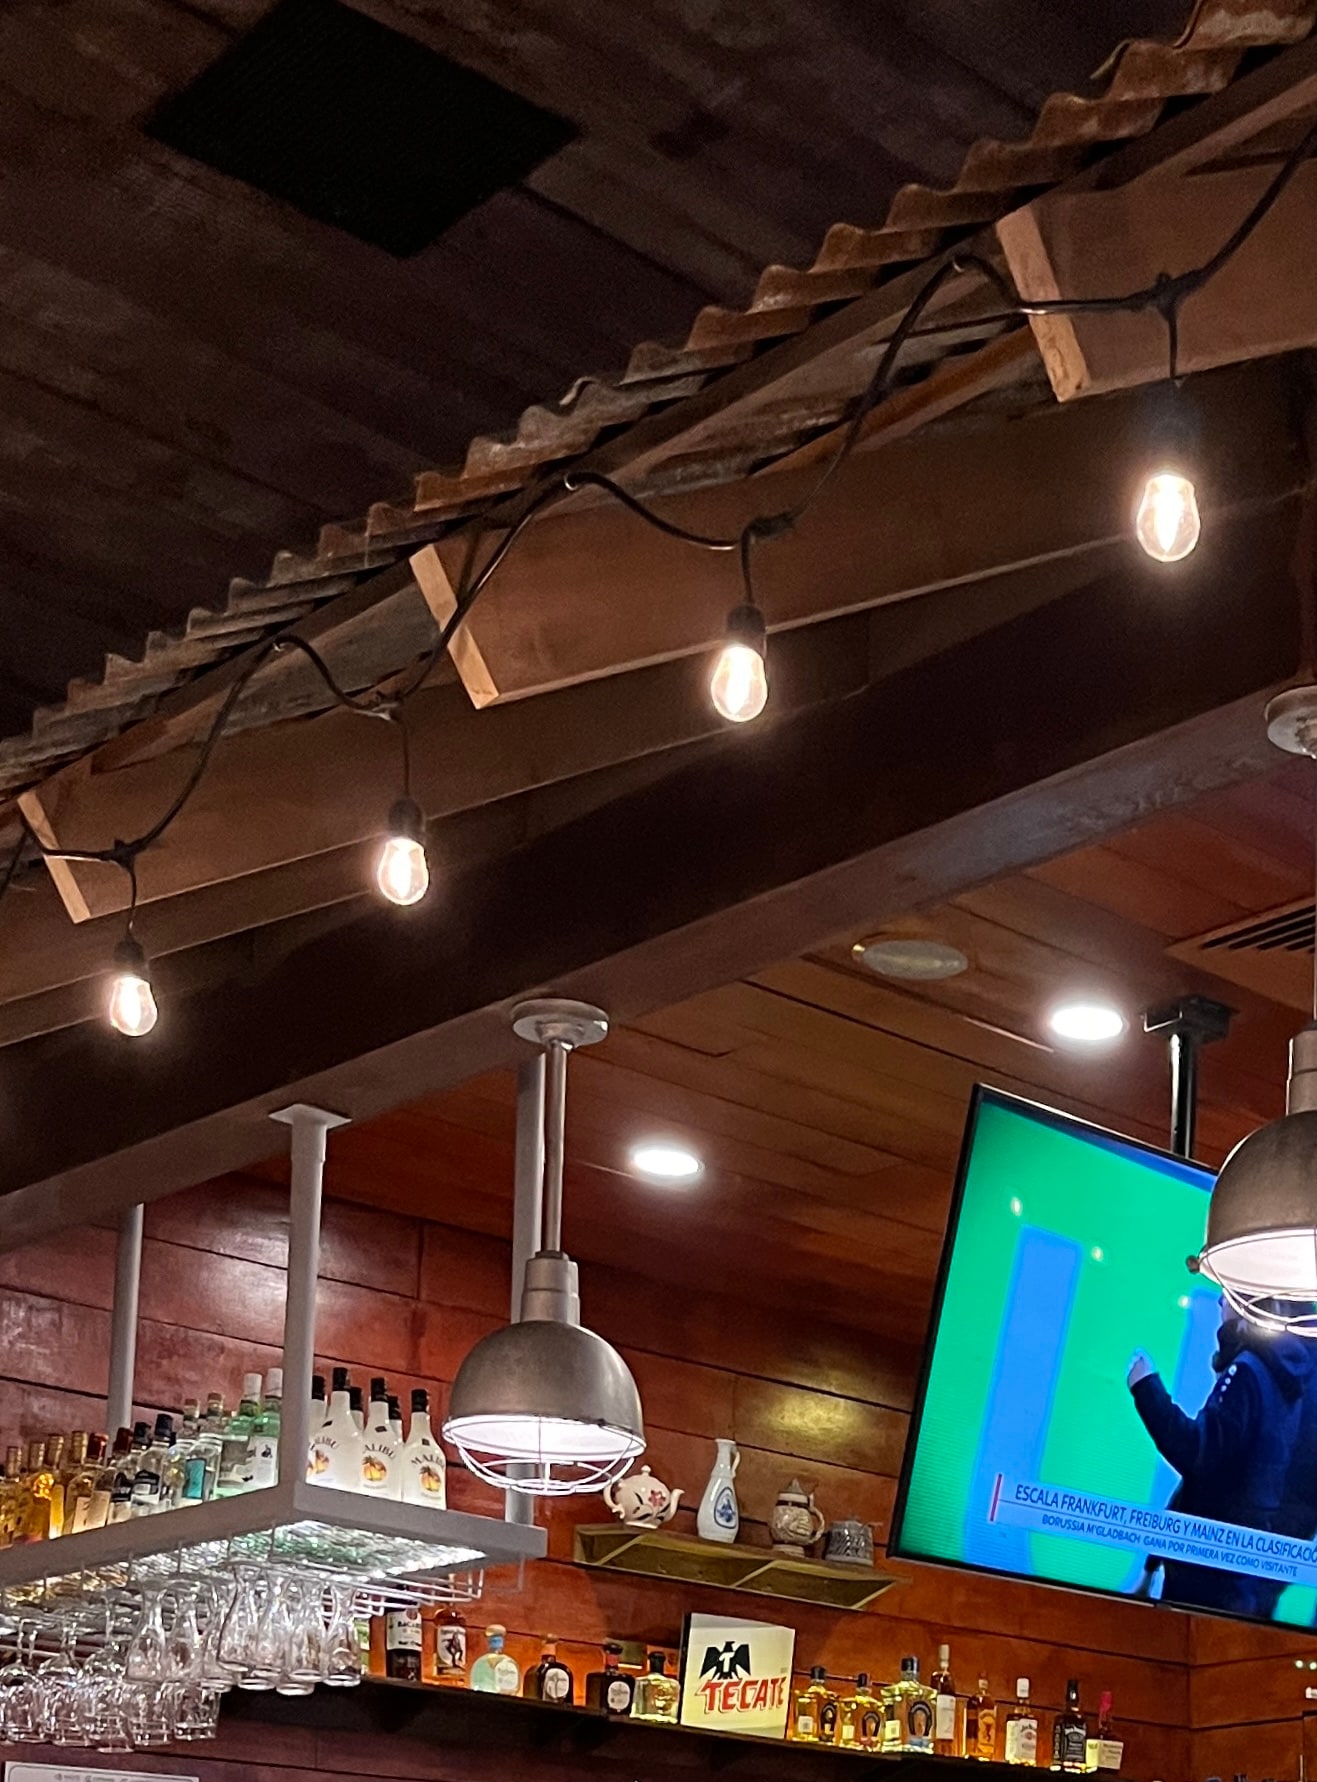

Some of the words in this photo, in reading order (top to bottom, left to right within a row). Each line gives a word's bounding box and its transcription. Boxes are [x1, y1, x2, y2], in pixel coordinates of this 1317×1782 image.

[1015, 1484, 1059, 1509] ESCALA
[1060, 1494, 1128, 1525] FRANKFURT,
[1129, 1509, 1180, 1534] FREIBURG
[1183, 1521, 1191, 1535] Y
[1191, 1522, 1224, 1543] MAINZ
[1225, 1530, 1240, 1546] EN
[1240, 1534, 1254, 1550] LA
[1042, 1513, 1085, 1533] BORUSSIA
[1143, 1535, 1167, 1550] GANA
[1167, 1540, 1186, 1555] POR
[1185, 1543, 1220, 1561] PRIMERA
[1220, 1550, 1236, 1564] VEZ
[1236, 1553, 1260, 1569] COMO
[1260, 1558, 1298, 1577] VISITANTE
[699, 1676, 787, 1712] TECATE
